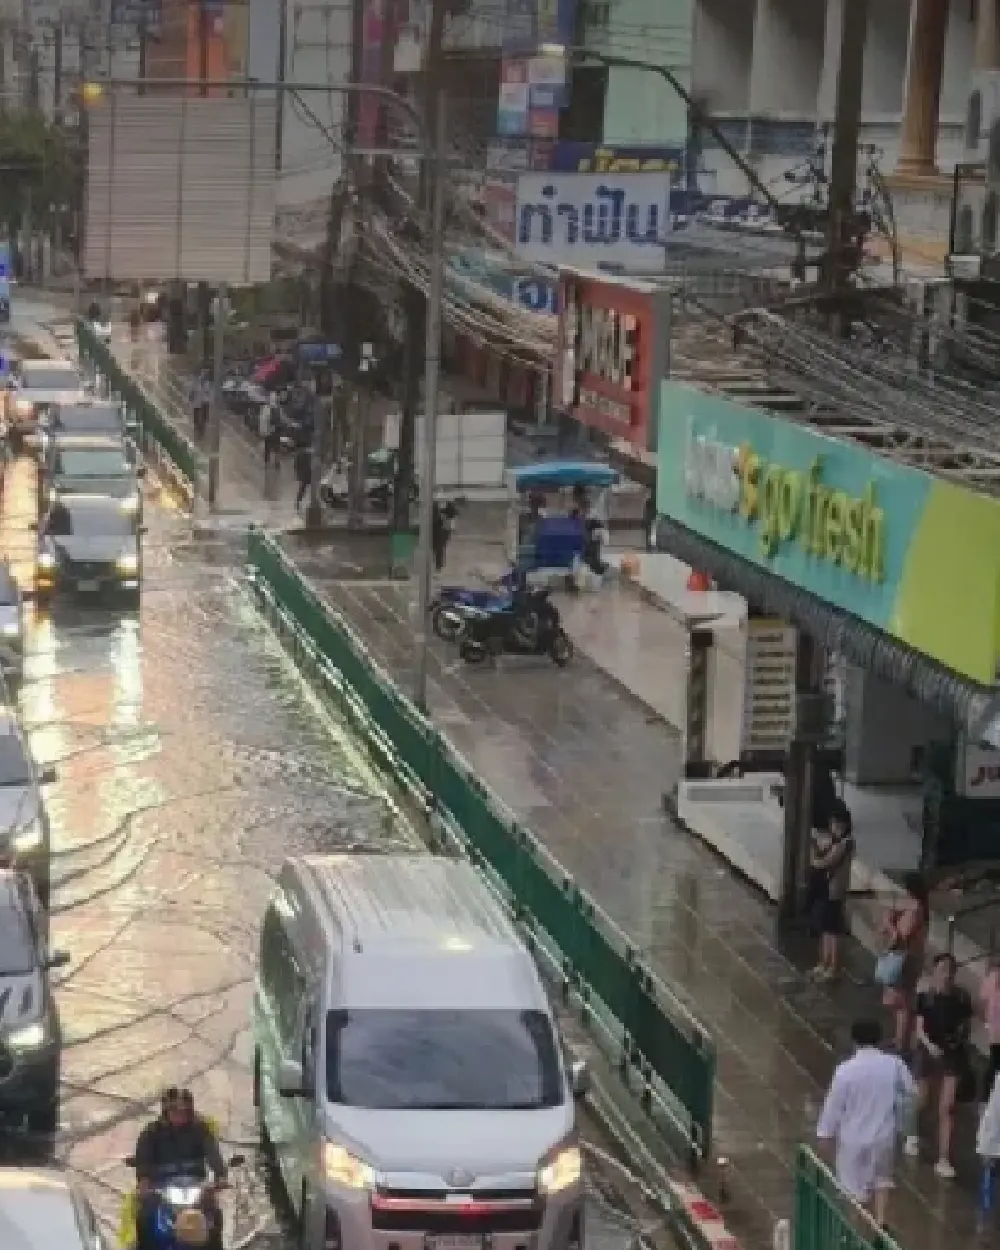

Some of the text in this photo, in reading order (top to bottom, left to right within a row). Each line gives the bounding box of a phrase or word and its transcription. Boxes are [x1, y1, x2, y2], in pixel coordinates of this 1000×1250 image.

[518, 185, 658, 244] ทำฟัน
[758, 462, 806, 558] go
[807, 452, 884, 583] fresh
